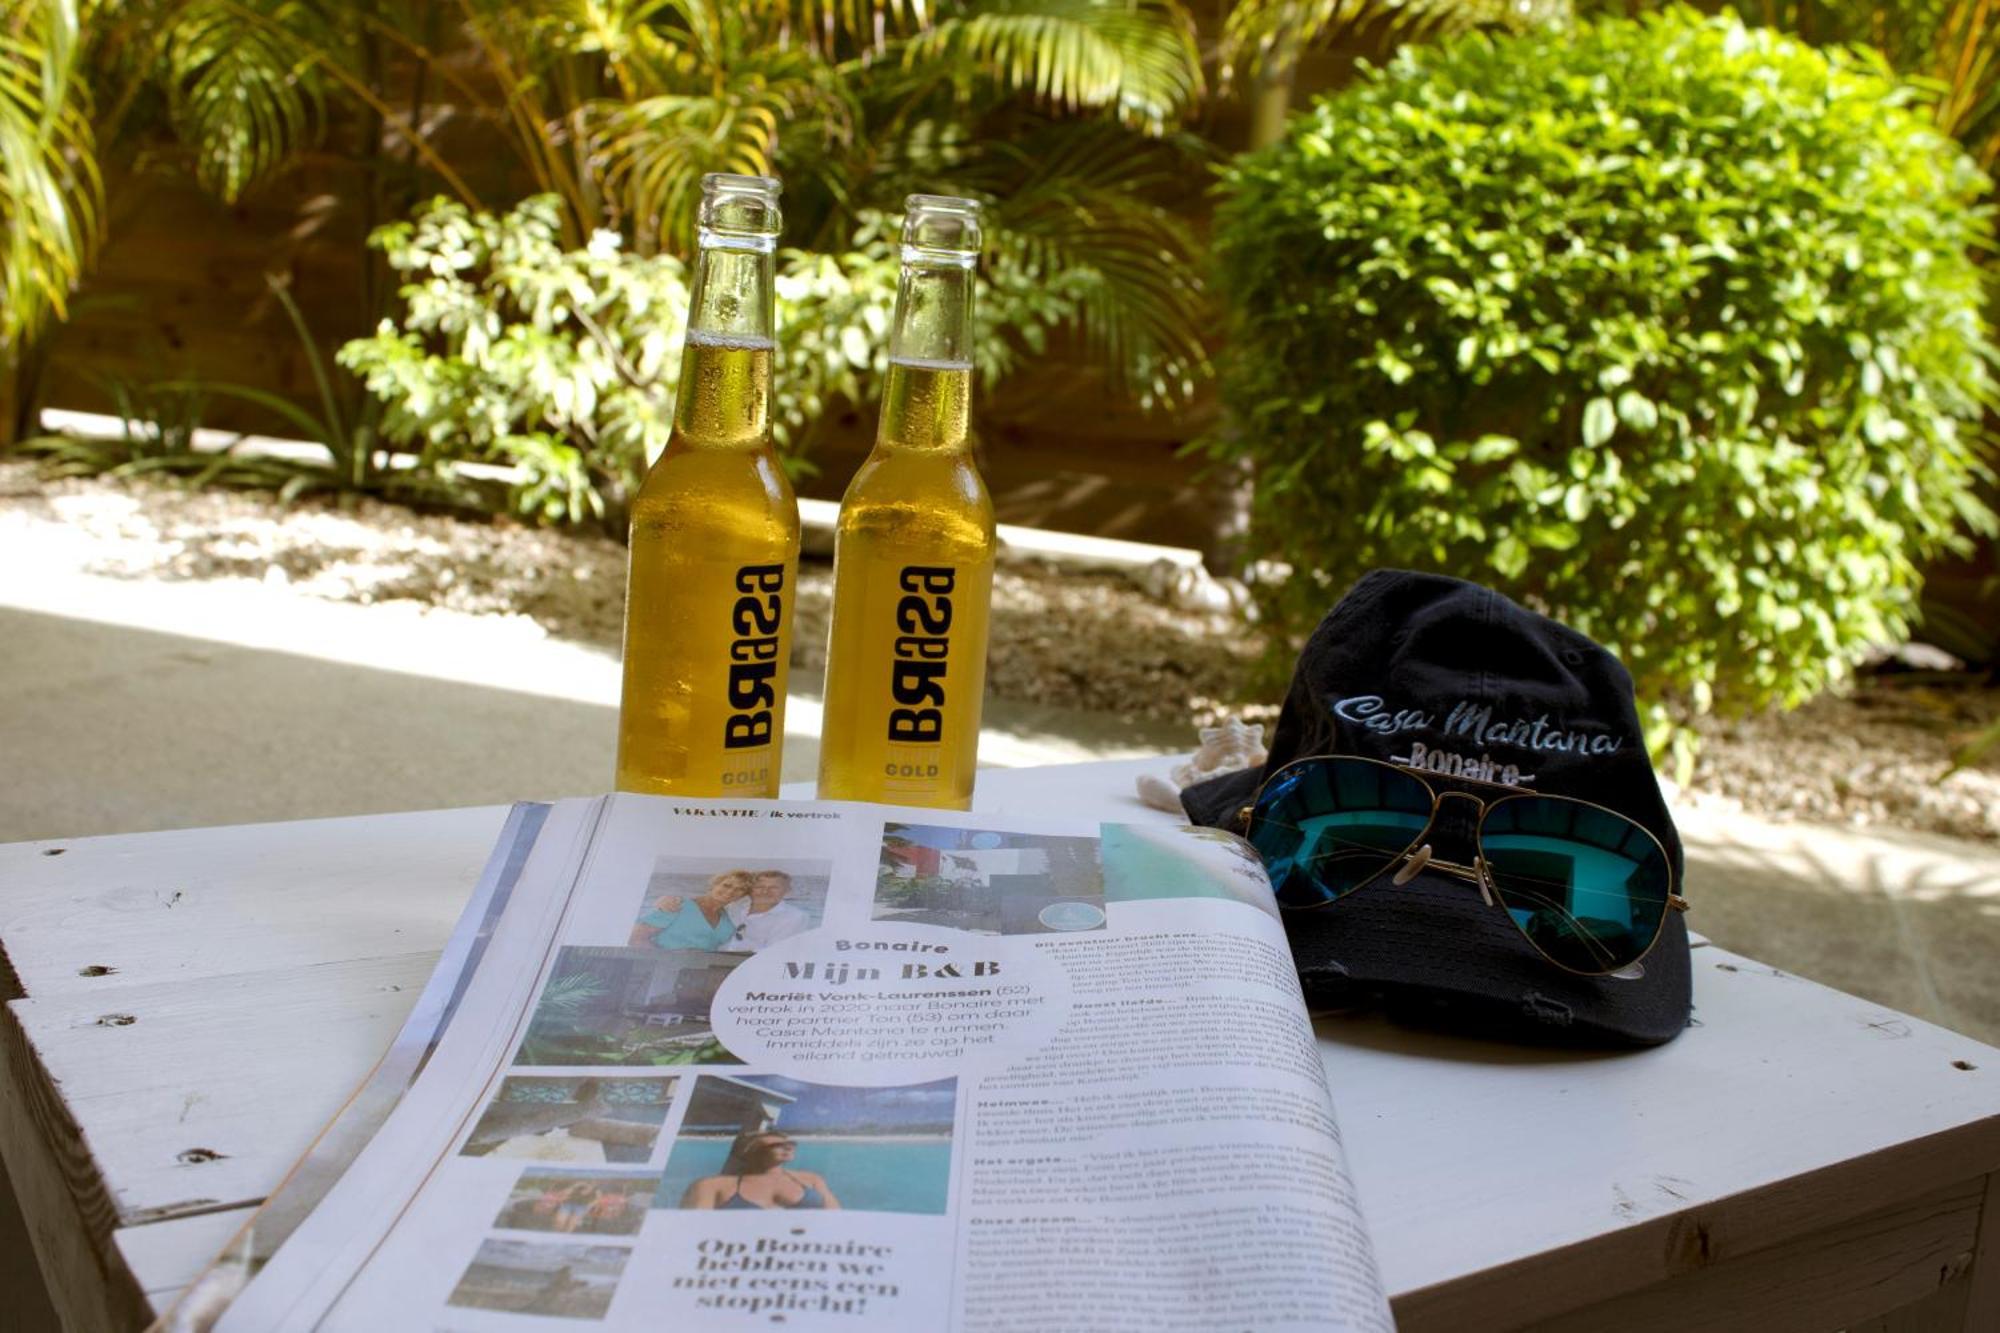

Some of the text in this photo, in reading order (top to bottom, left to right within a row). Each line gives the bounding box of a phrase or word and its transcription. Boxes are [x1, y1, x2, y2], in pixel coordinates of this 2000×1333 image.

[1334, 695, 1435, 735] Casa
[885, 763, 939, 778] GOLD
[1407, 742, 1520, 786] Bonaire
[721, 768, 769, 786] GOLD
[787, 812, 841, 820] vertrok
[836, 940, 949, 954] Bonaire
[783, 961, 1001, 985] Mijn B&B
[820, 989, 991, 1001] Vonk-Laurenssen
[728, 997, 1045, 1013] vertrok in 2020 naar Bonaire met
[736, 1016, 780, 1025] haar
[786, 1015, 860, 1027] partner
[947, 1012, 979, 1021] om
[984, 1010, 1031, 1019] daar
[755, 1027, 807, 1037] Casa
[930, 1037, 958, 1047] op
[963, 1035, 993, 1044] het
[697, 1238, 893, 1258] Op Bonaire
[672, 1275, 739, 1290] niet
[835, 1282, 900, 1297] een
